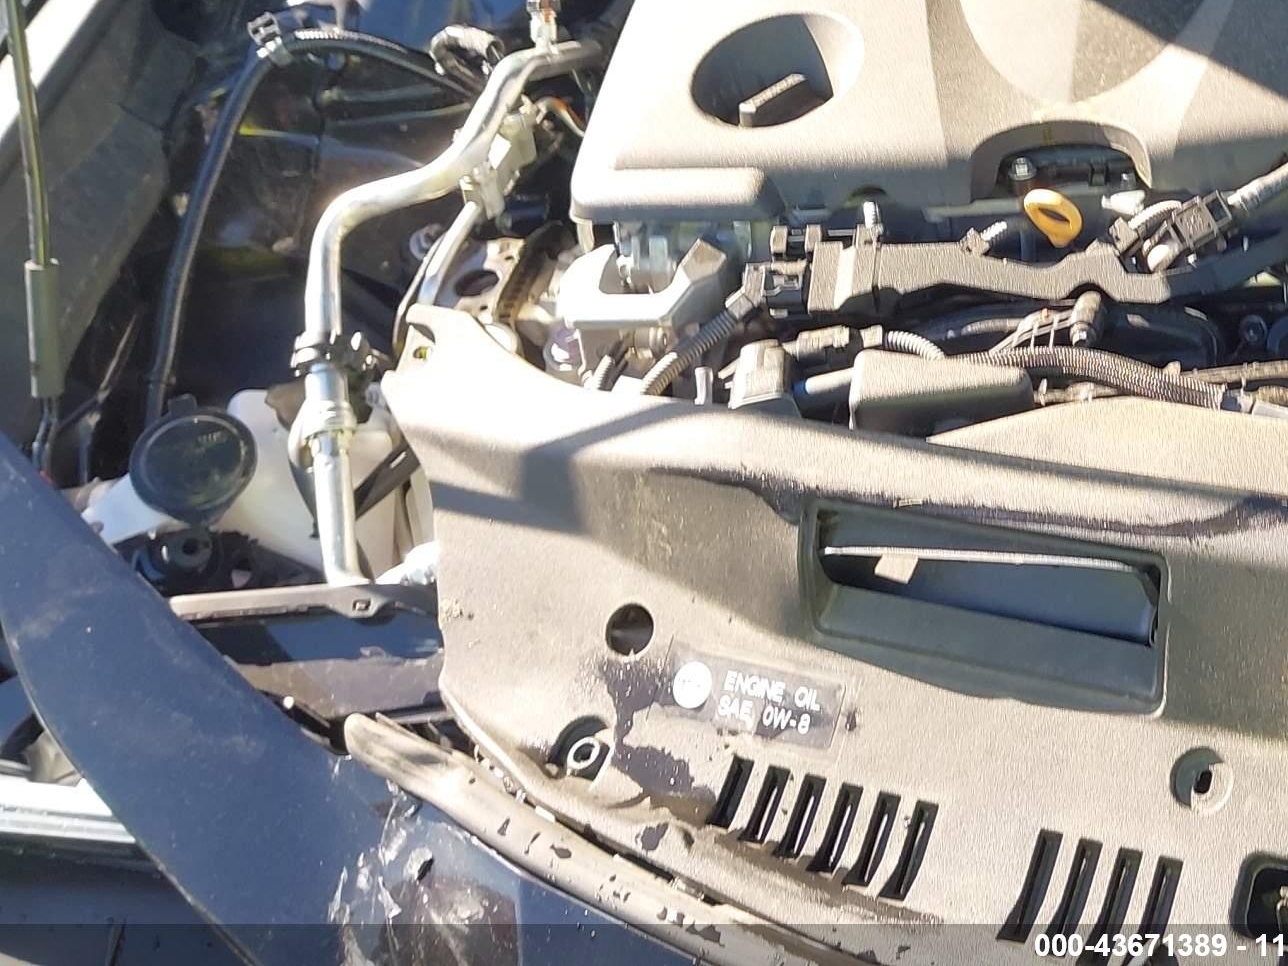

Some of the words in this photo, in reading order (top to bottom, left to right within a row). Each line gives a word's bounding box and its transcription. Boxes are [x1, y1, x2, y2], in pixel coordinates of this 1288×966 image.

[724, 670, 785, 702] ENGINE
[794, 686, 822, 712] OIL
[717, 695, 754, 722] SAE
